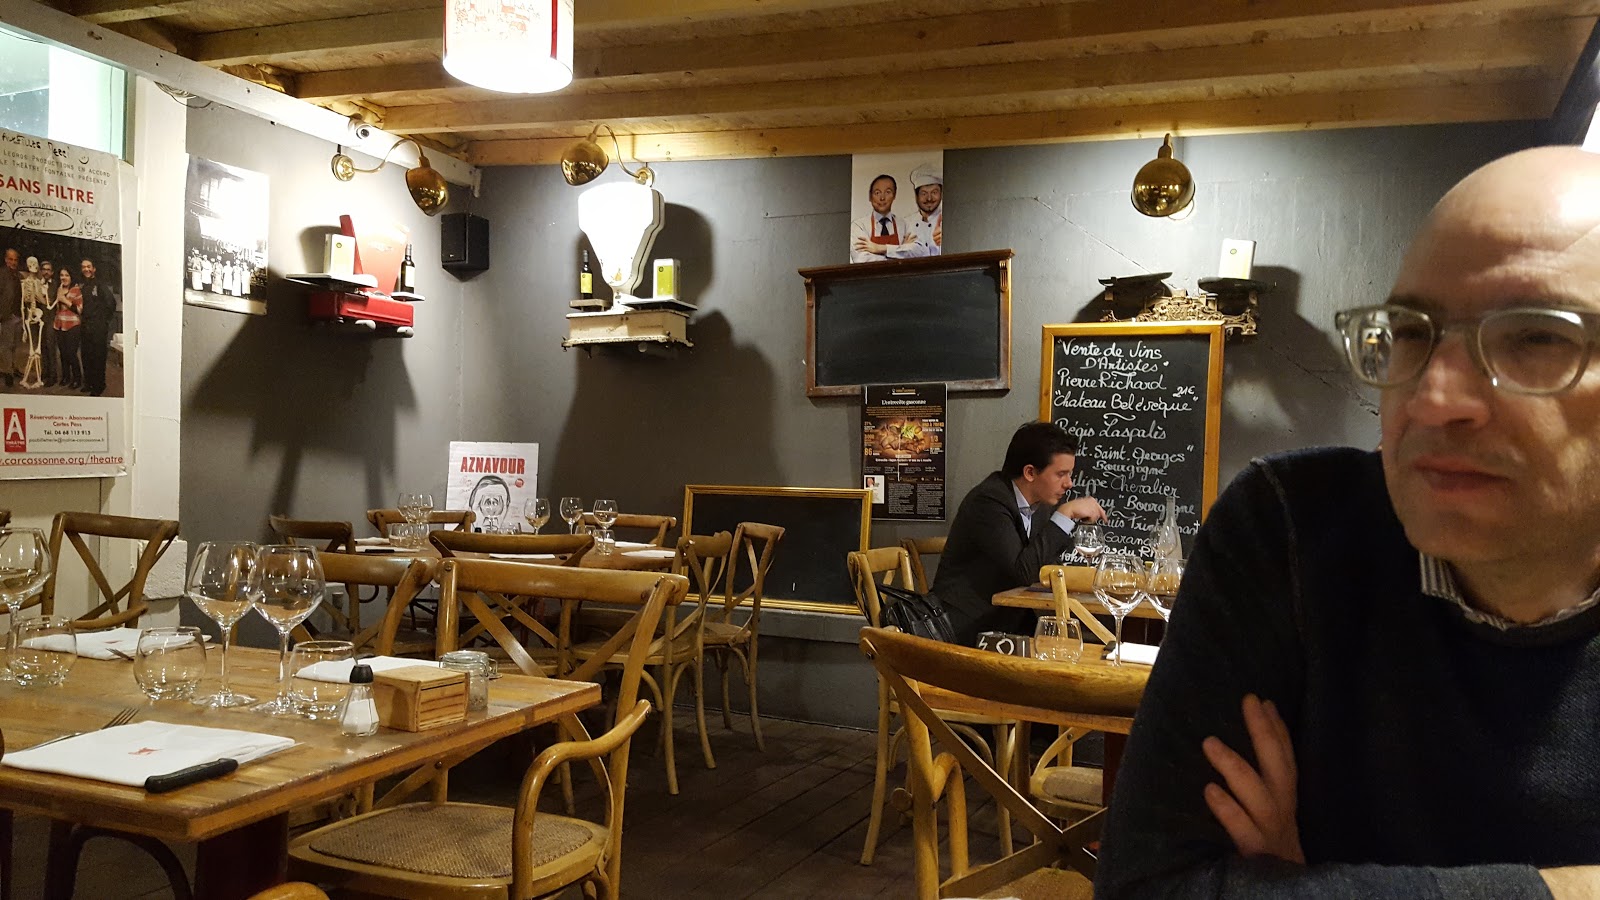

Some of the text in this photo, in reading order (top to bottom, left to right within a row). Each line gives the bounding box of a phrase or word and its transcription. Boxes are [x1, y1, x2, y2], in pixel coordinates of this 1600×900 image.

[47, 183, 94, 205] FILTRE
[1103, 342, 1124, 358] de
[1057, 367, 1167, 391] Pierre Richard
[1054, 417, 1096, 446] Régis
[460, 456, 526, 475] AZNAVOUR
